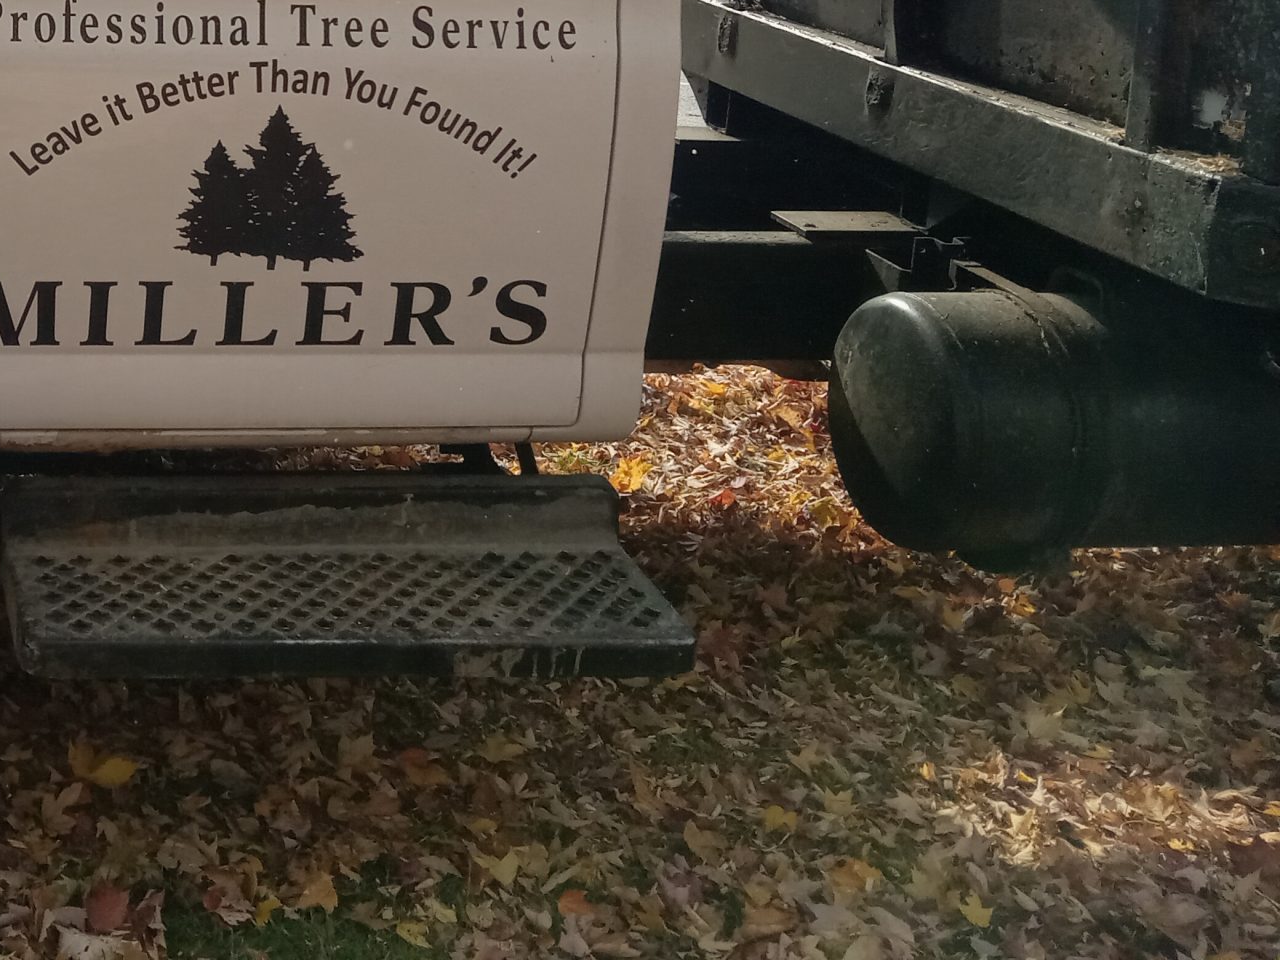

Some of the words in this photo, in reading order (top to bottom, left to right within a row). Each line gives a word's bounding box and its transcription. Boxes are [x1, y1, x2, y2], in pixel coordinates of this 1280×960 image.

[290, 4, 389, 49] Tree
[411, 5, 577, 50] Service
[9, 112, 102, 176] Leave
[102, 94, 133, 126] it
[136, 70, 239, 114] Better
[249, 59, 330, 96] Than
[344, 67, 399, 110] You
[403, 86, 502, 155] Found
[492, 138, 537, 179] It!
